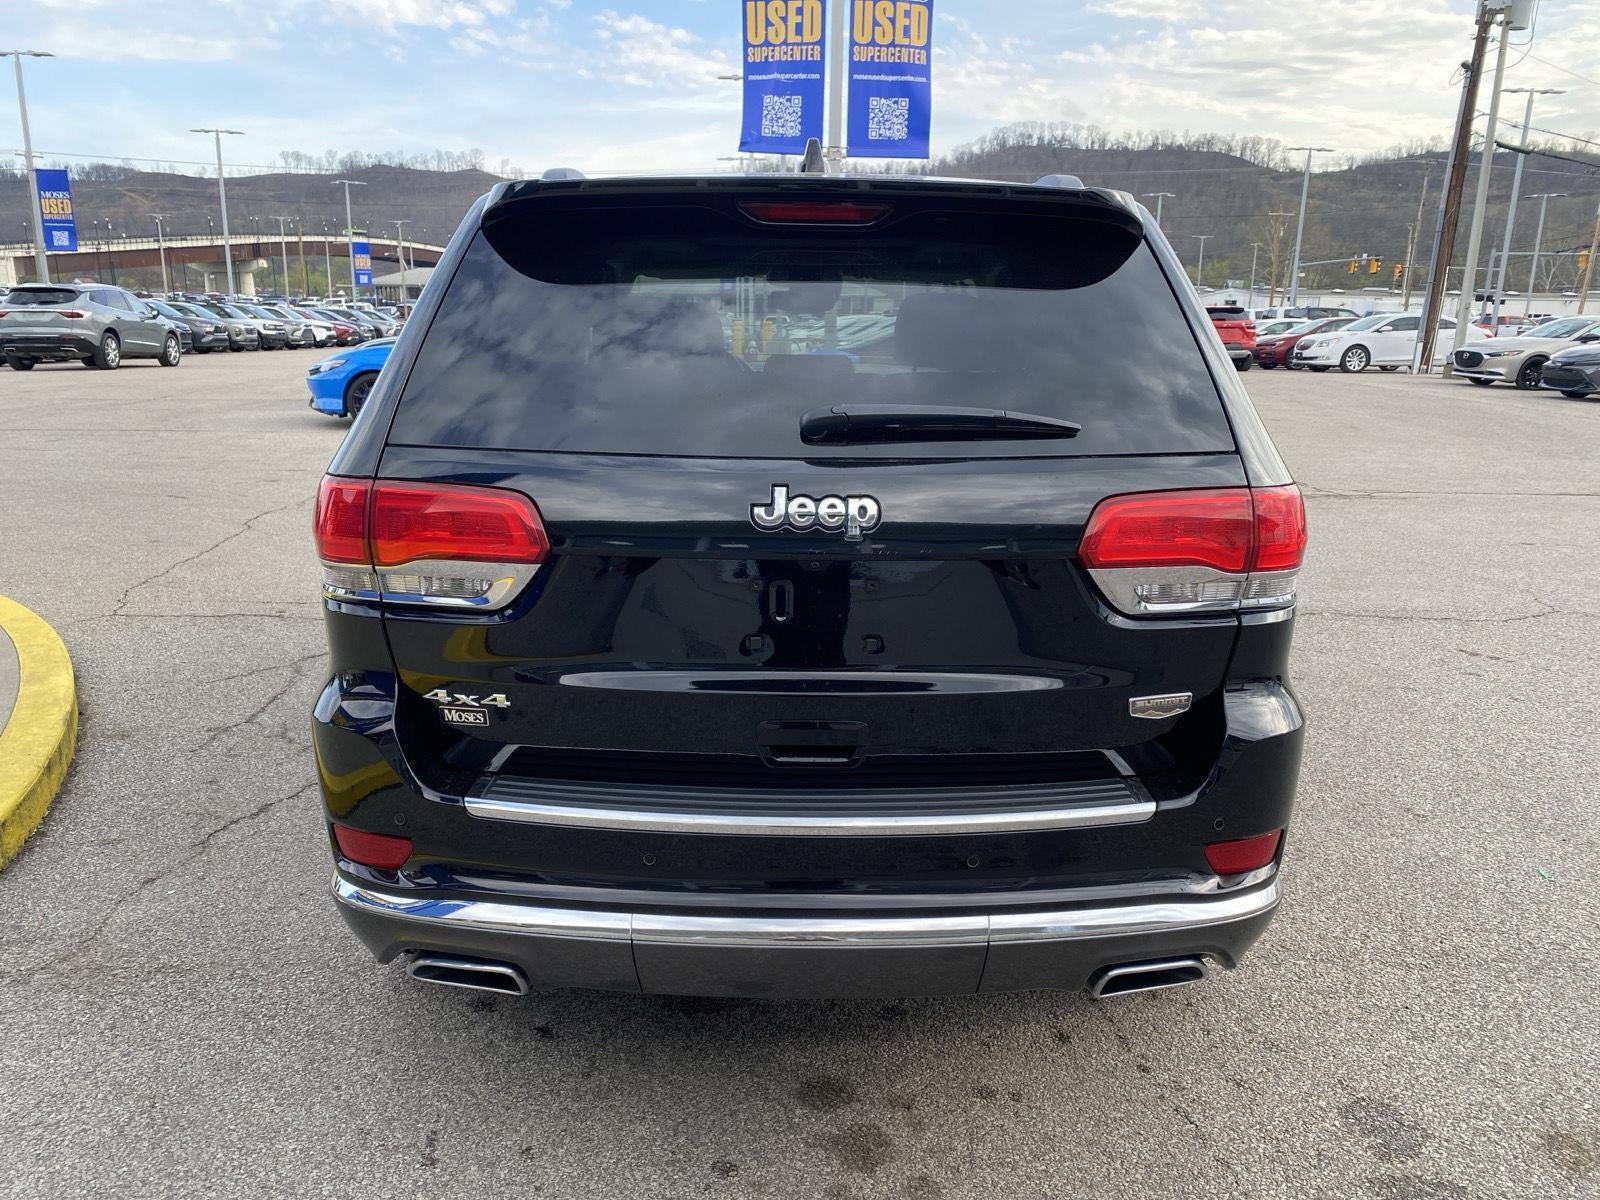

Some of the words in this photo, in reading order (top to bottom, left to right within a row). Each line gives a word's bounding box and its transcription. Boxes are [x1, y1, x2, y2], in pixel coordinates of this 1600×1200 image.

[746, 0, 822, 46] USED
[853, 0, 929, 47] USED
[747, 45, 821, 63] SUPERCENTER
[853, 45, 927, 65] SUPERCENTER
[40, 190, 70, 199] MOSES
[41, 198, 72, 214] USED
[750, 482, 882, 541] Jeep
[443, 709, 484, 723] MOSES
